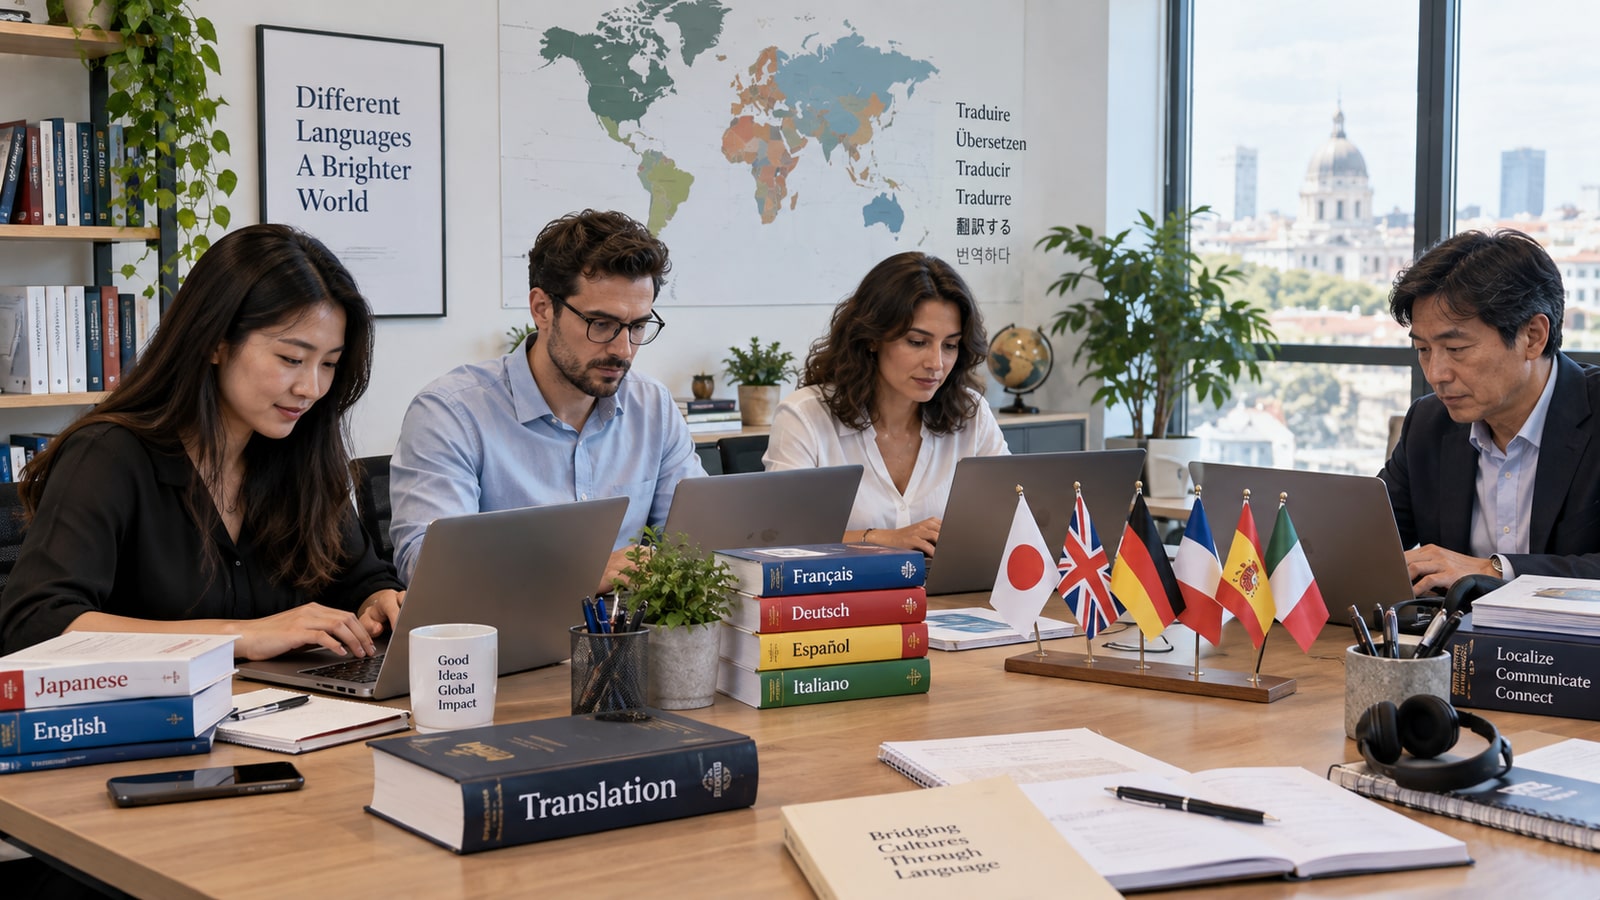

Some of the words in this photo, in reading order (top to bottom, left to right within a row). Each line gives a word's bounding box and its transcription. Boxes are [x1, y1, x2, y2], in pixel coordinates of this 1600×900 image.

[296, 86, 400, 115] Different
[956, 102, 1010, 122] Traduire
[296, 119, 411, 152] Languages
[956, 128, 1026, 150] Übersetzen
[297, 154, 315, 176] A
[322, 154, 411, 185] Brighter
[956, 160, 1010, 177] Traducir
[297, 188, 369, 212] World
[956, 189, 1011, 205] Tradurre
[957, 217, 1010, 235] 翻訳する
[957, 246, 1010, 265] 번역하다
[793, 567, 852, 585] Français
[792, 603, 849, 620] Deutsch
[793, 639, 849, 659] Español
[1497, 646, 1554, 666] Localize
[438, 654, 469, 666] Good
[439, 669, 468, 681] Ideas
[1496, 667, 1591, 689] Communicate
[35, 674, 128, 698] Japanese
[438, 683, 475, 696] Global
[794, 678, 849, 695] Italiano
[1496, 686, 1554, 704] Connect
[438, 698, 477, 712] Impact
[34, 716, 106, 742] English
[518, 776, 678, 821] Translation
[869, 824, 962, 842] Bridging
[877, 837, 970, 854] Cultures
[884, 848, 983, 867] Through
[894, 861, 1000, 880] Language
